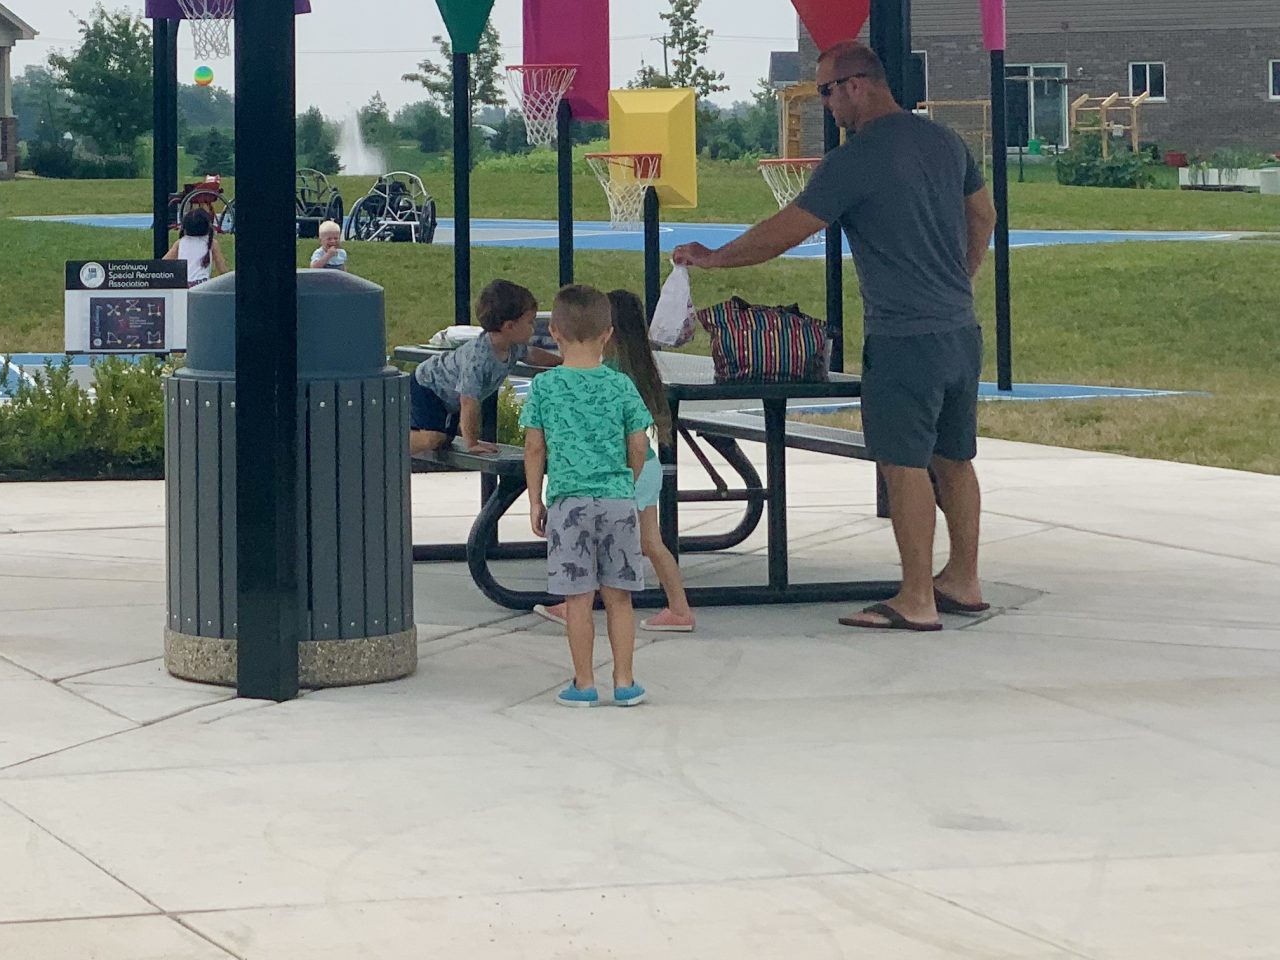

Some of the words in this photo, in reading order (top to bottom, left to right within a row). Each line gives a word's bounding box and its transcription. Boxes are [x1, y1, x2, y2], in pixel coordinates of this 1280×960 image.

[108, 263, 148, 271] Lincolnway
[108, 271, 134, 279] Special
[135, 271, 174, 279] Recreation
